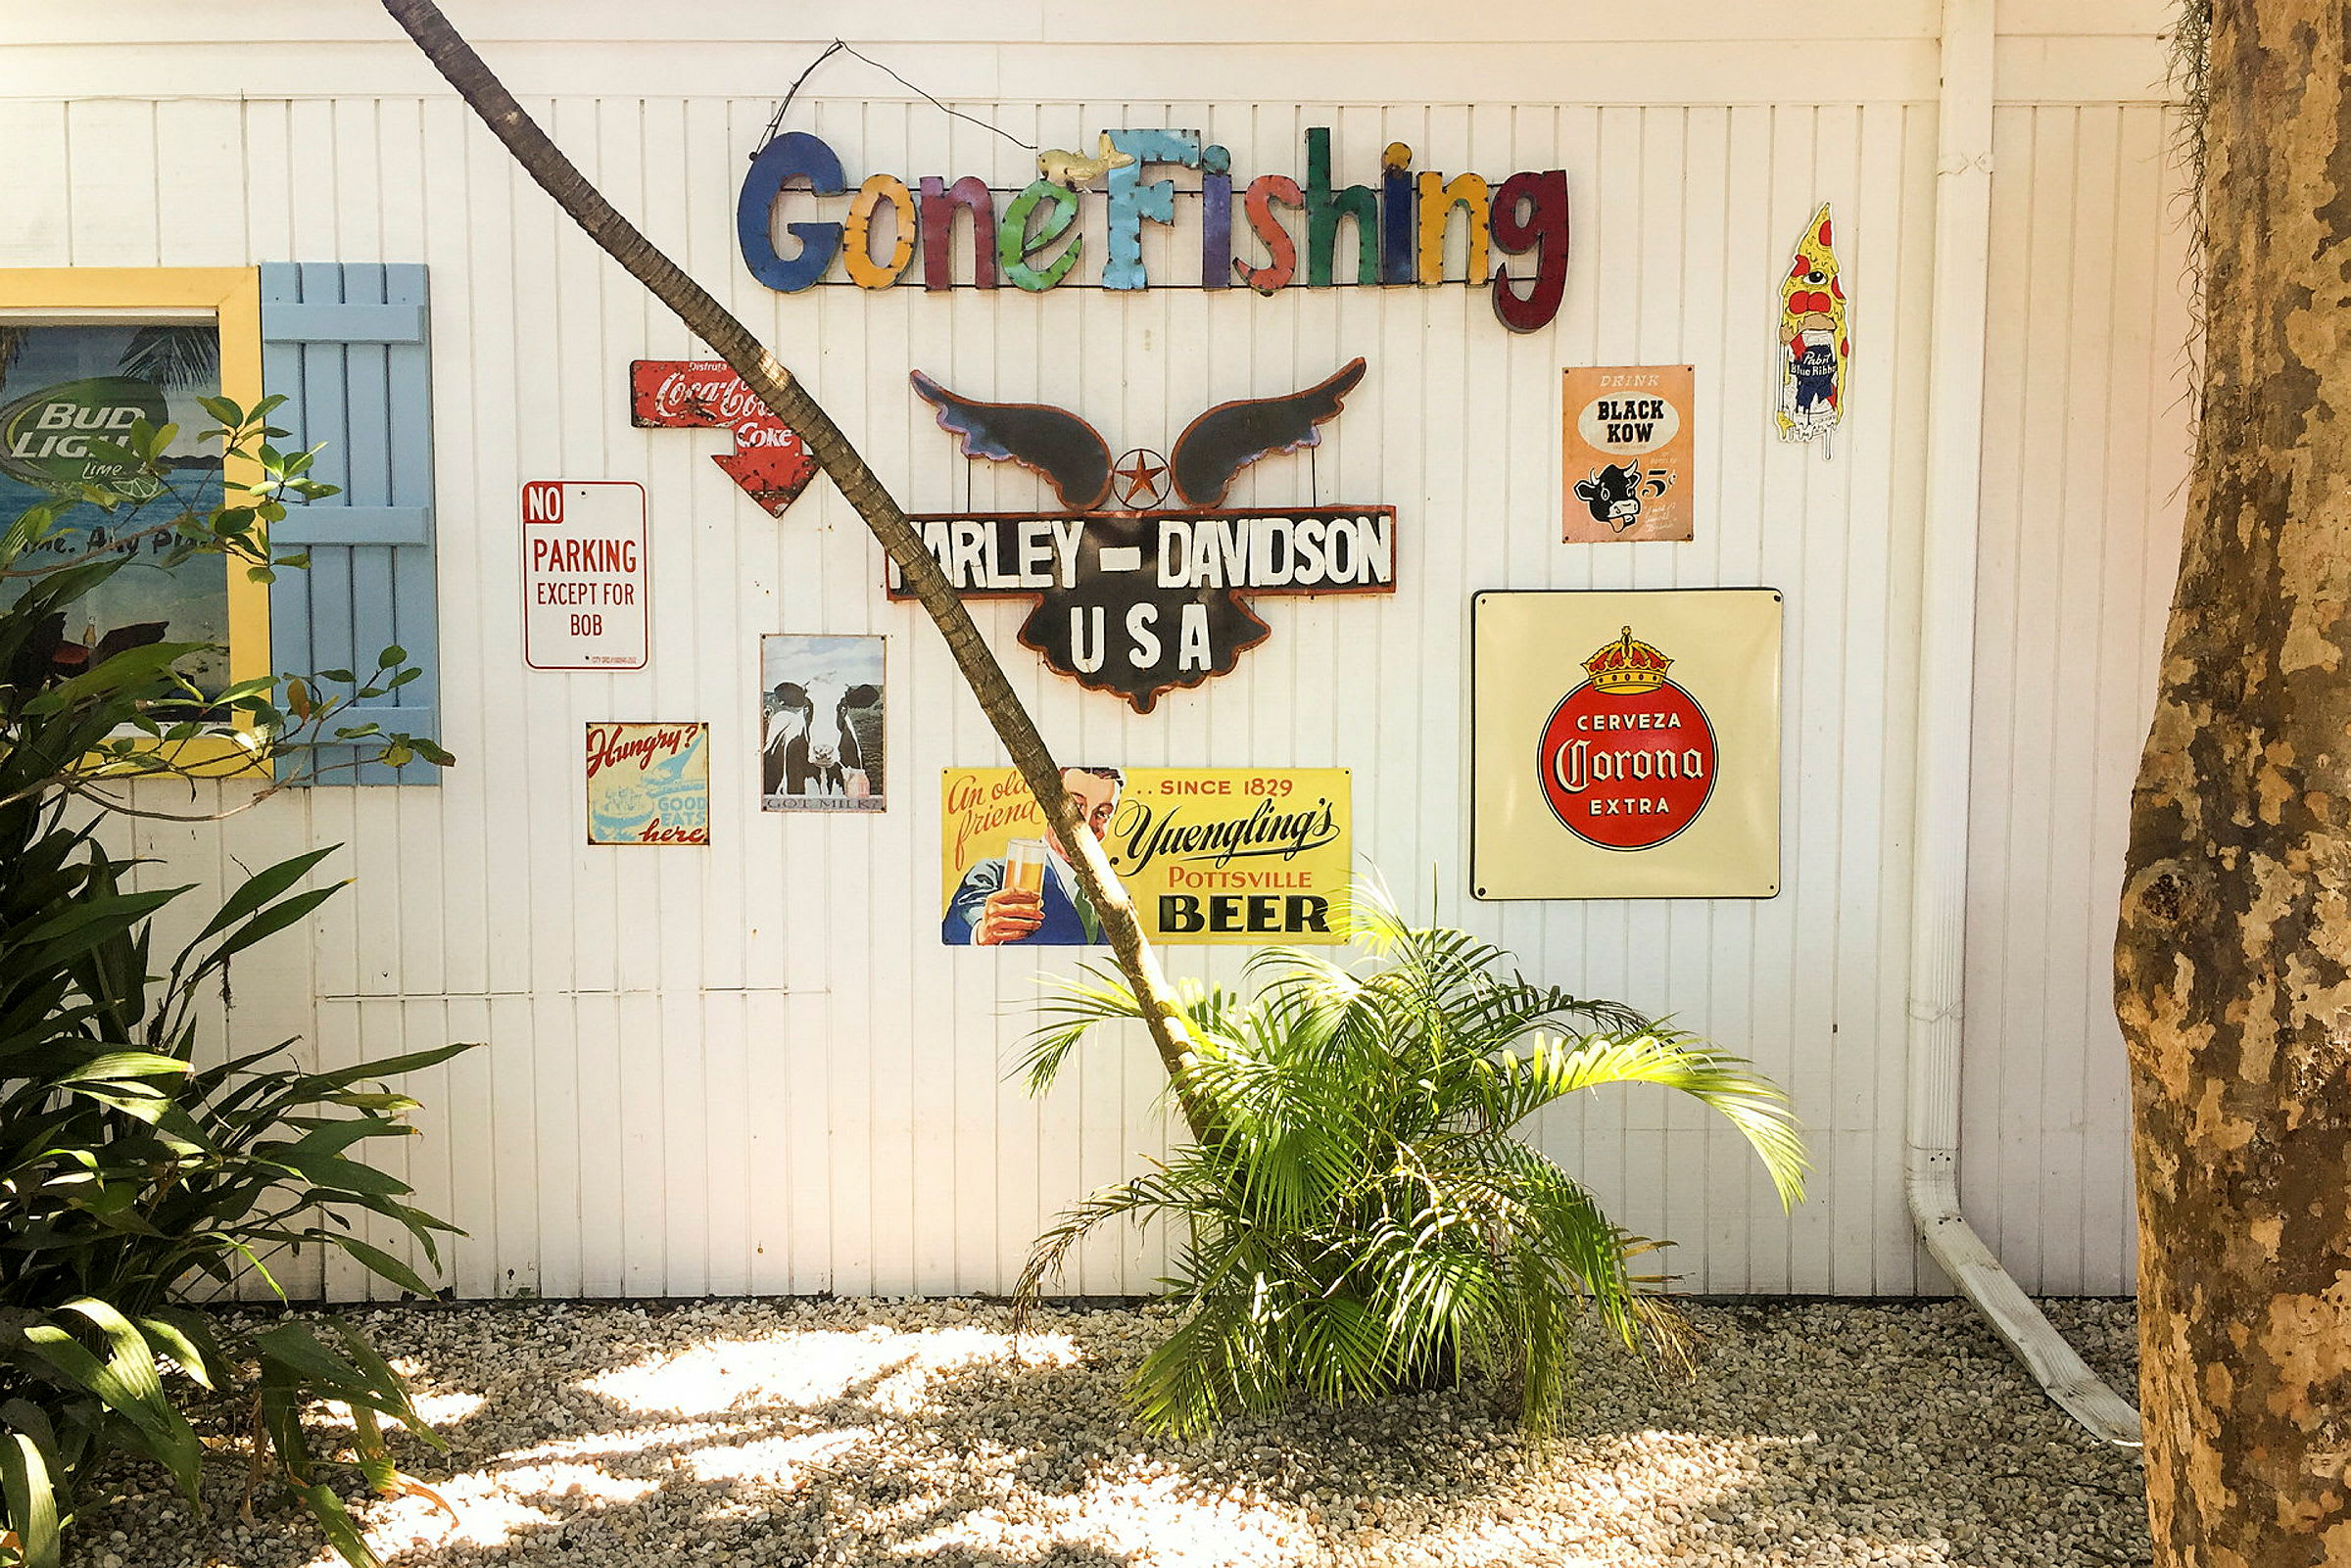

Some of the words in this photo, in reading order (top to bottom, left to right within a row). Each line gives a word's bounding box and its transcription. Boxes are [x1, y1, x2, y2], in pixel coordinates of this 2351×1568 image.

[737, 131, 1082, 294] Gone
[1101, 127, 1569, 333] Fishing
[689, 361, 728, 372] Disfruta
[1791, 362, 1811, 376] Blue
[1803, 351, 1832, 366] Pabst
[1600, 375, 1659, 388] DRINK
[36, 403, 146, 429] BUD
[1598, 400, 1664, 421] BLACK
[11, 431, 141, 458] LIG
[737, 422, 793, 449] Coke
[1607, 422, 1655, 444] KOW
[82, 460, 123, 480] Lime
[527, 486, 561, 521] NO
[533, 539, 637, 573] PARKING
[1157, 516, 1393, 589] DAVIDSON
[537, 582, 597, 605] EXCEPT
[603, 582, 635, 605] FOR
[570, 613, 602, 637] BOB
[1577, 712, 1682, 732] CERVEZA
[588, 725, 698, 778] Hungry?
[1555, 737, 1704, 794] Corona
[947, 775, 985, 815] An
[991, 770, 1030, 801] old
[1160, 780, 1231, 796] SINCE
[1243, 778, 1293, 797] 1829
[657, 796, 705, 812] GOOD
[767, 798, 808, 809] GOT
[819, 798, 882, 809] MILK?
[1589, 797, 1669, 817] EXTRA
[639, 817, 705, 843] here
[660, 811, 705, 827] EATS
[955, 799, 1042, 872] friend
[1110, 796, 1341, 879] Yuengling's
[1169, 866, 1313, 888] POTTSVILLE
[1158, 894, 1331, 933] BEER
